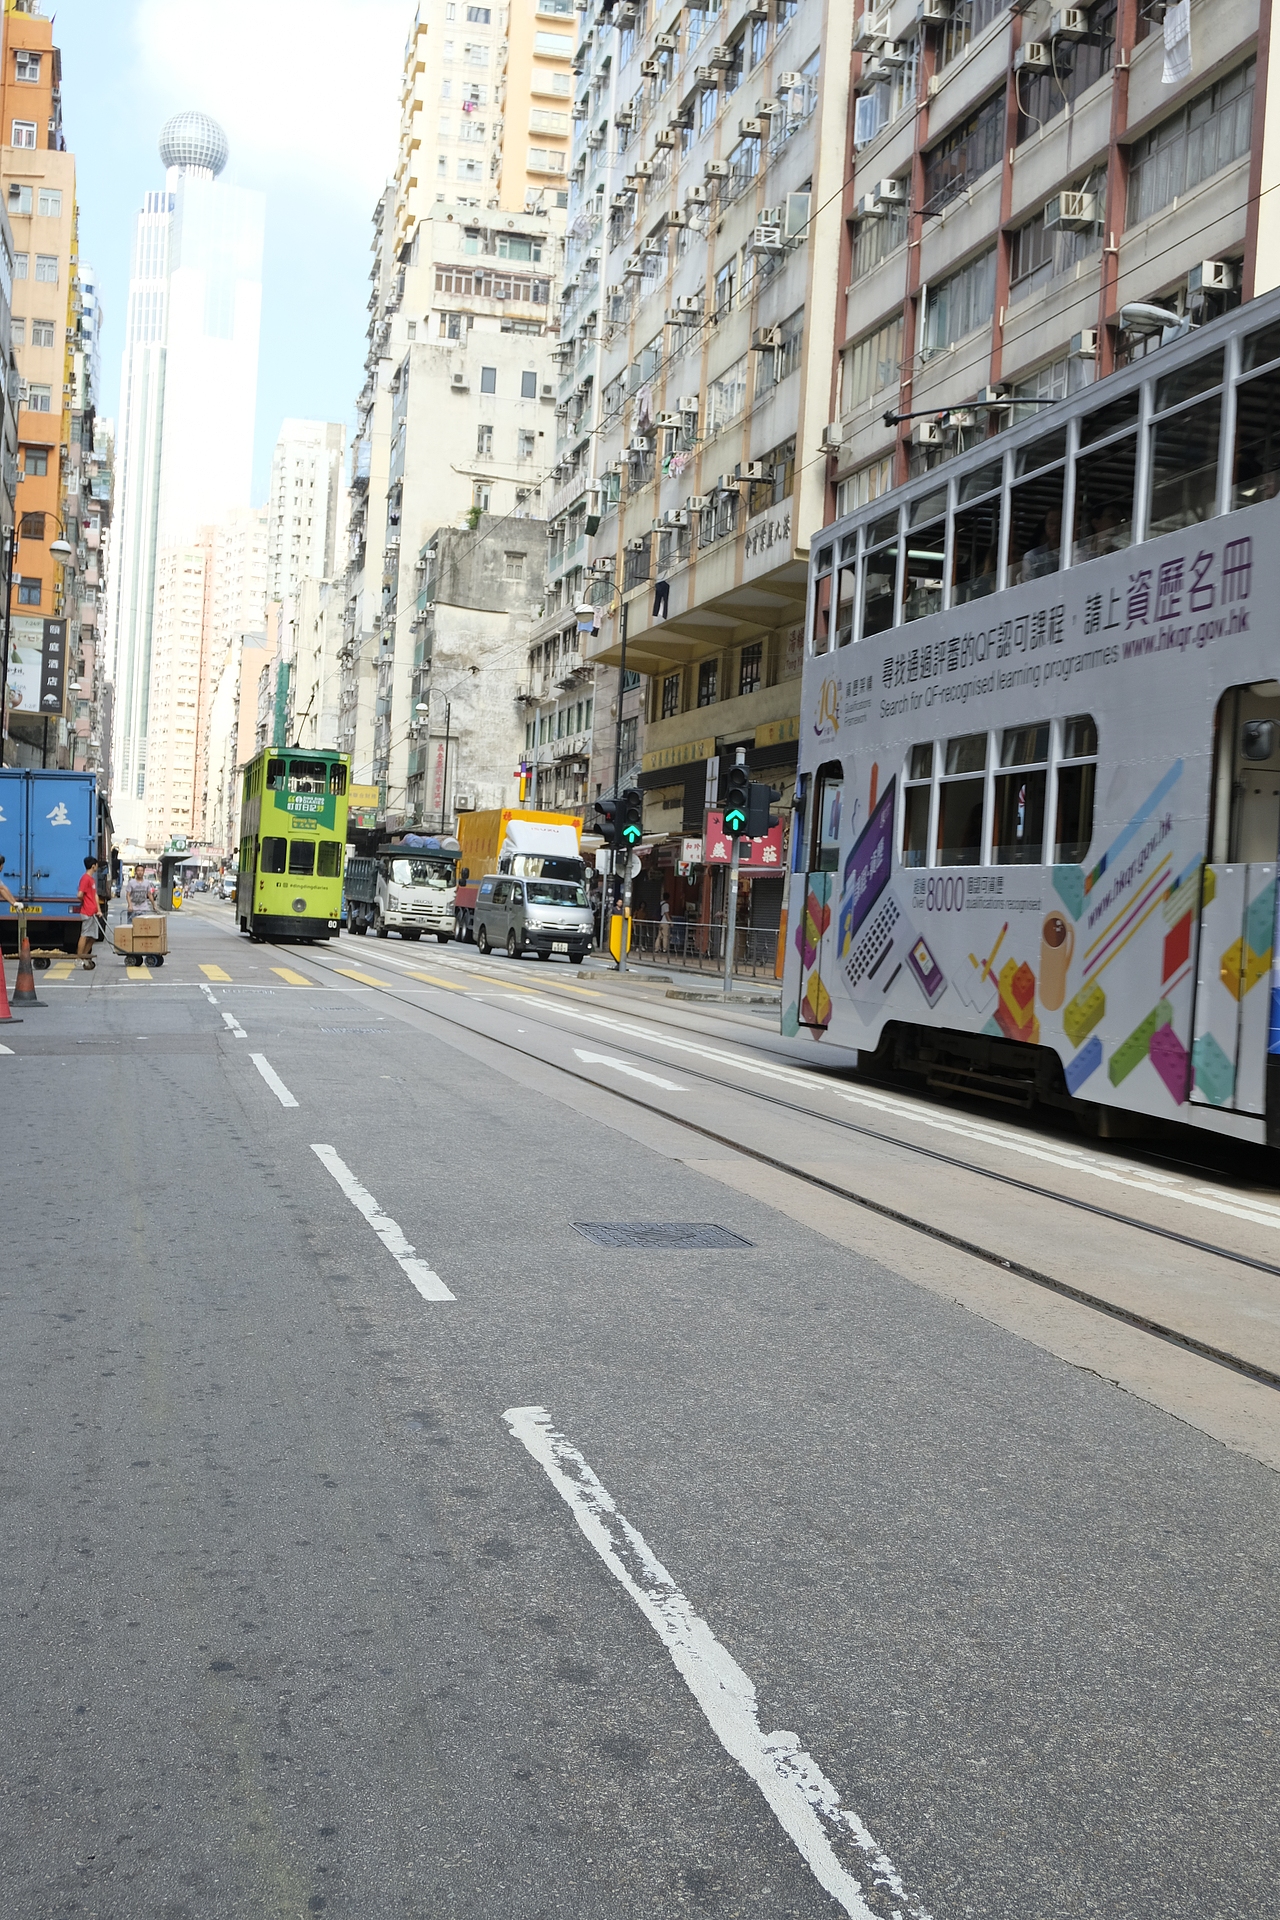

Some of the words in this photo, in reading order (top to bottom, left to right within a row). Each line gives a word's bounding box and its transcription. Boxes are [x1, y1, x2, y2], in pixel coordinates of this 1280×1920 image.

[880, 693, 910, 718] Search
[910, 689, 923, 710] for
[925, 671, 994, 708] QF-recognised
[996, 662, 1041, 691] learning
[1044, 644, 1120, 685] programmes
[1121, 606, 1251, 660] www.hkqr.gov.hk
[926, 876, 965, 912] 8000
[1088, 812, 1173, 930] www.hkqr.gov.hk
[327, 920, 338, 929] 80
